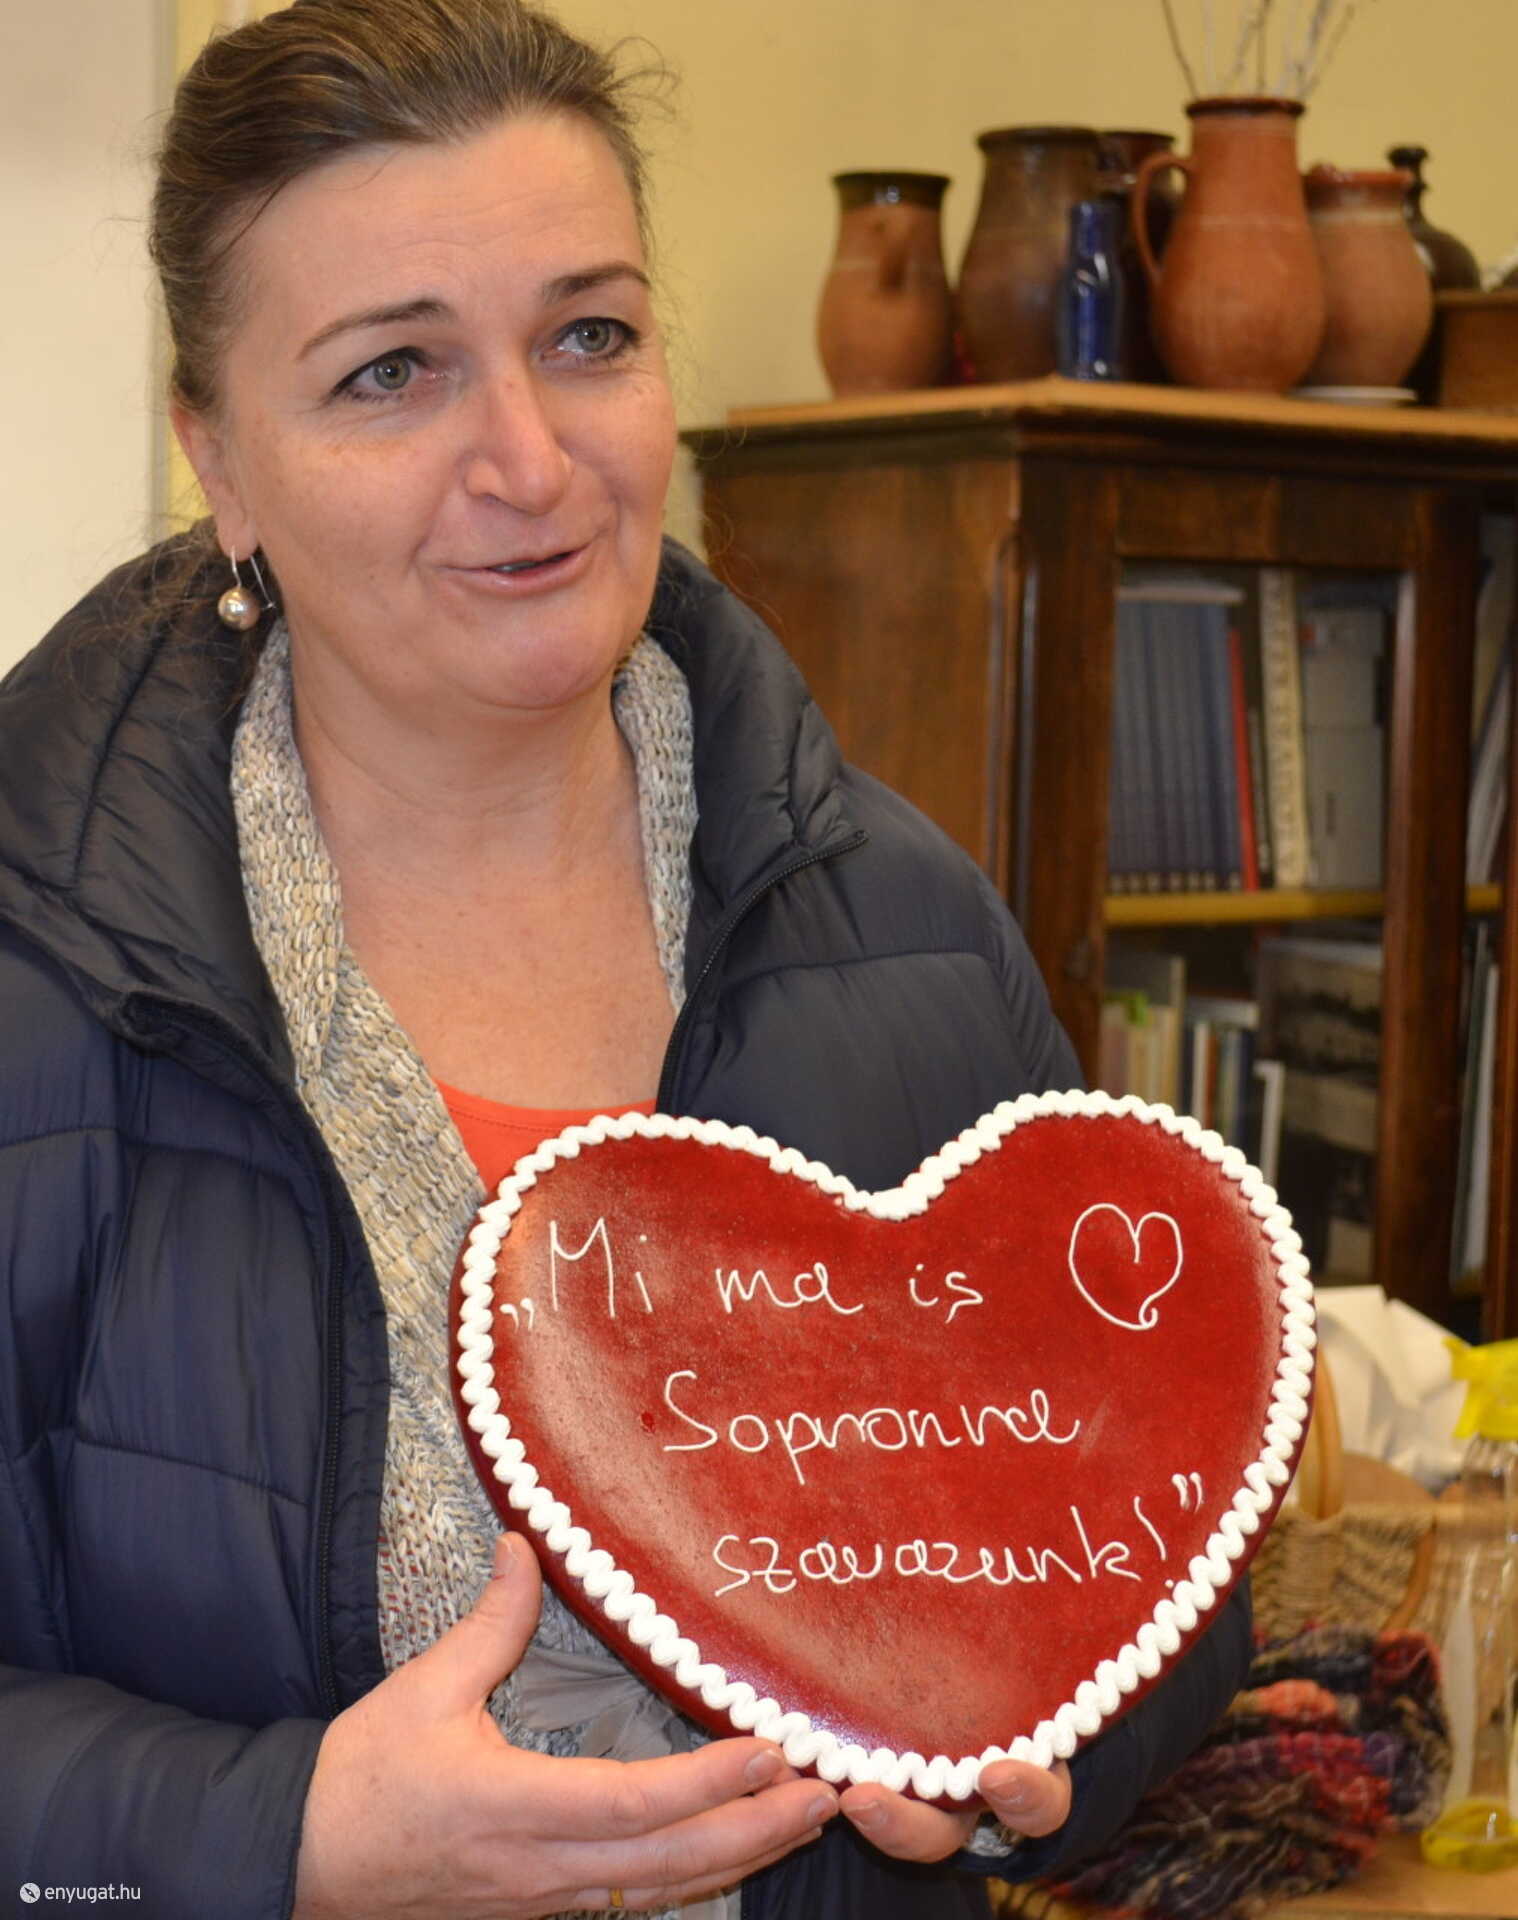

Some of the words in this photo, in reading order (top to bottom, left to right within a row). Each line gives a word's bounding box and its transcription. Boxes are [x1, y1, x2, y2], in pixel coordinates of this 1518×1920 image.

[714, 1262, 865, 1315] ma
[908, 1263, 984, 1324] is
[662, 1370, 1081, 1486] Sopronra
